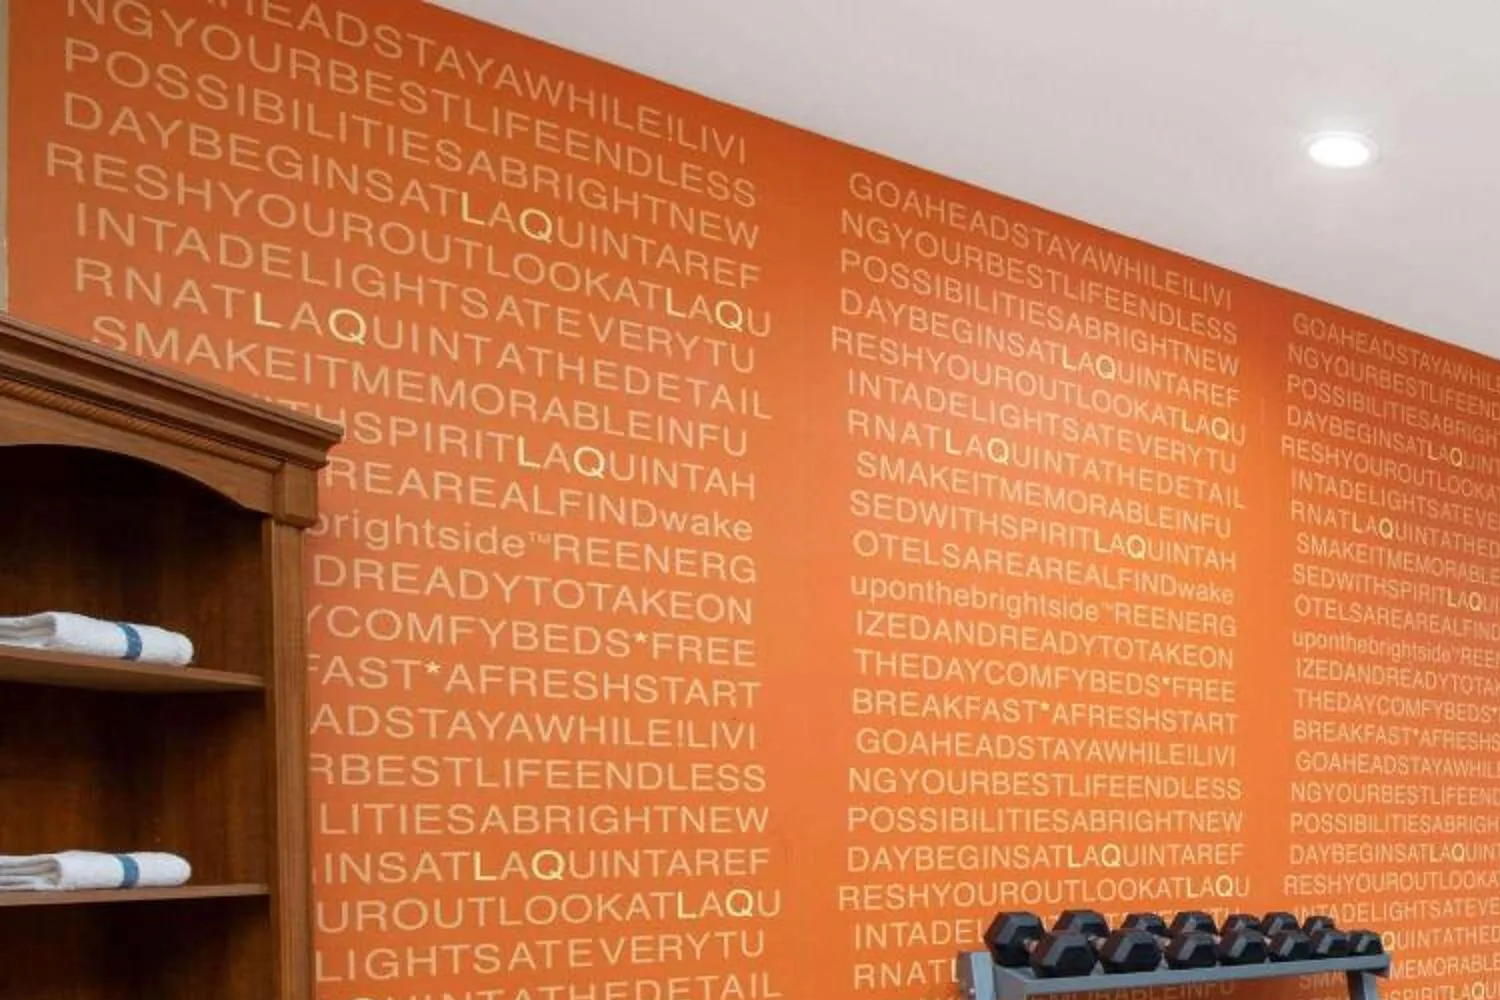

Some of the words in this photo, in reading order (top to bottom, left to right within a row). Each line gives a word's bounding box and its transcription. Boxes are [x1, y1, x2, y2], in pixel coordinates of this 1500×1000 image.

[208, 0, 750, 168] EADSTAYAWHILE!LIVI
[60, 34, 762, 255] POSSIBILITIESABRIGHTNEW
[60, 88, 762, 296] DAYBEGINSATLAQUINTAREF
[44, 139, 772, 340] RESHYOUROUTLOOKATLAQU
[76, 201, 757, 378] INTADELIGHTSATEVERYTU
[838, 209, 1238, 347] NGYOURBESTLIFEENDLESS
[847, 172, 1233, 313] GOAHEADSTAYAWHILE!LIVI
[75, 255, 772, 422] RNATLAQUINTATHEDETAIL
[837, 249, 1241, 381] POSSIBILITIESABRIGHTNEW
[837, 288, 1241, 413] DAYBEGINSATLAQUINTAREF
[92, 313, 749, 459] SMAKEITMEMORABLEINFU
[828, 326, 1247, 447] RESHYOUROUTLOOKATLAQU
[845, 370, 1237, 477] INTADELIGHTSATEVERYTU
[258, 393, 758, 503] HSPIRITLAQUINTAH
[845, 410, 1246, 511] RNATLAQUINTATHEDETAIL
[854, 451, 1232, 541] SMAKEITMEMORABLEINFU
[847, 489, 1238, 574] SEDWITHSPIRITLAQUINTAH
[850, 529, 1235, 606] OTELSAREAREALFINDwake
[313, 552, 754, 627] DREADYTOTAKEON
[854, 609, 1235, 671] IZEDANDREADYTOTAKEON
[845, 766, 1242, 801] NGYOURBESTLIFEENDLESS
[854, 727, 1237, 768] GOAHEADSTAYAWHILE!LIVI
[313, 849, 770, 886] INSATLAQUINTAREF
[320, 801, 770, 836] LITIESABRIGHTNEW
[844, 805, 1244, 833] POSSIBILITIESABRIGHTNEW
[844, 844, 1244, 871] DAYBEGINSATLAQUINTAREF
[317, 890, 780, 936] UROUTLOOKATLAQU
[835, 876, 1250, 910] RESHYOUROUTLOOKATLAQU
[316, 932, 765, 985] LIGHTSATEVERYTU
